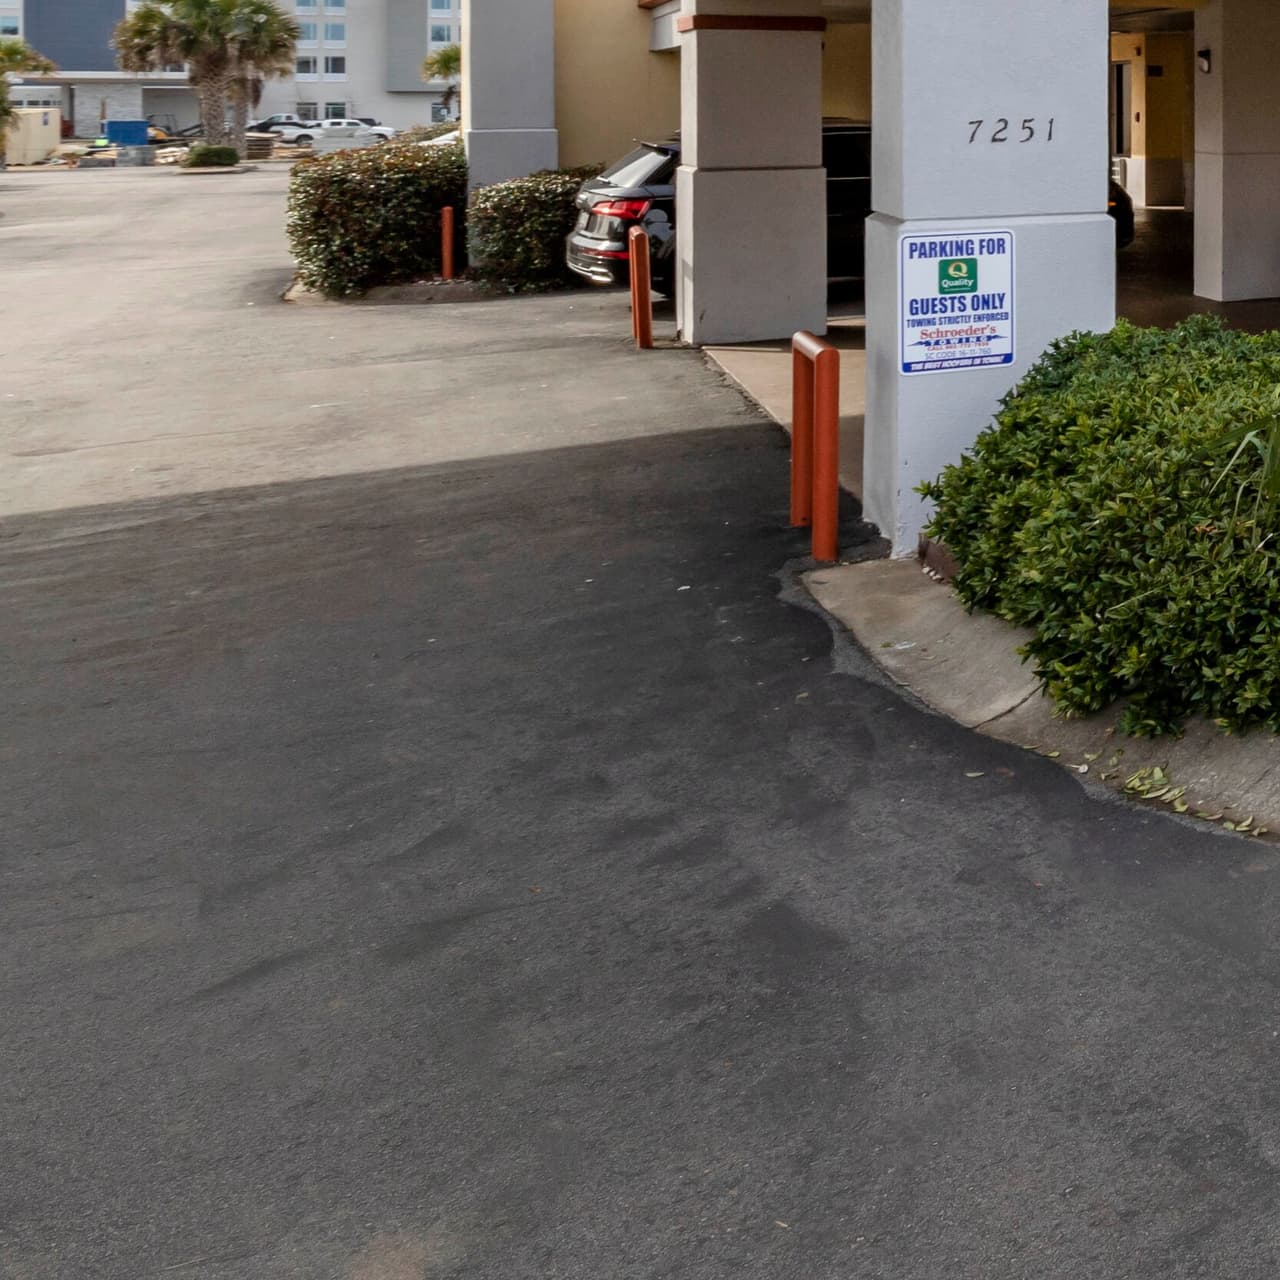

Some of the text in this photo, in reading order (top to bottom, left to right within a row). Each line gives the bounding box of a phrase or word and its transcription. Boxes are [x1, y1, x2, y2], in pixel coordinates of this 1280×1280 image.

[968, 118, 1054, 143] 7251
[909, 238, 1006, 259] PARKING FOR
[941, 278, 974, 288] Quality
[909, 293, 1006, 316] GUESTS ONLY
[907, 312, 1009, 328] TOWING STRICTLY ENFORCED
[920, 324, 997, 340] Schroeder's
